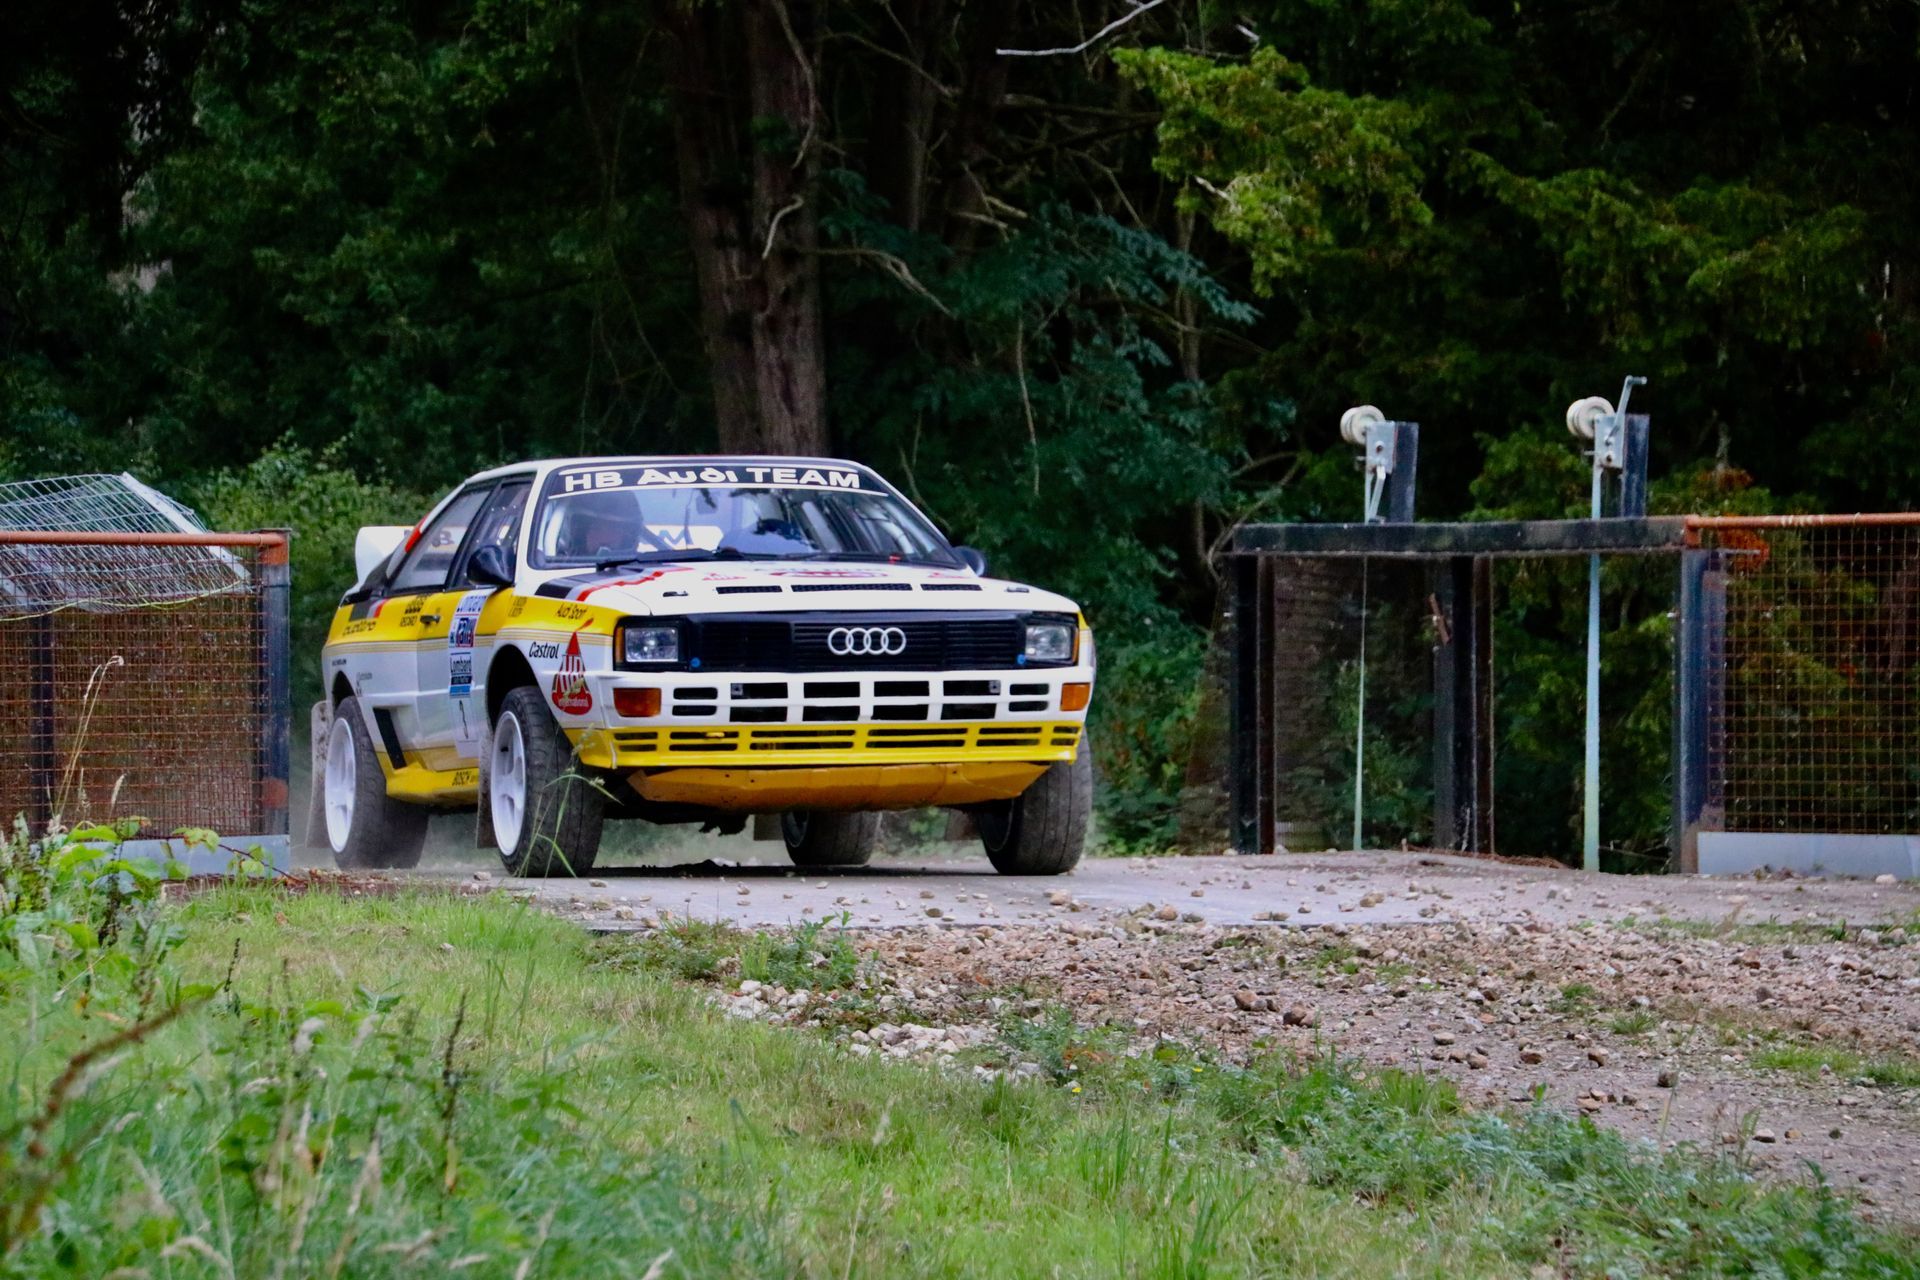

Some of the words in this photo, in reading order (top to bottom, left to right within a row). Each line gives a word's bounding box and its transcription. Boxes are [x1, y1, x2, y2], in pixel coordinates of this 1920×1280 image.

[565, 471, 623, 492] HB
[746, 467, 860, 489] TEAM
[529, 641, 560, 659] Castrol
